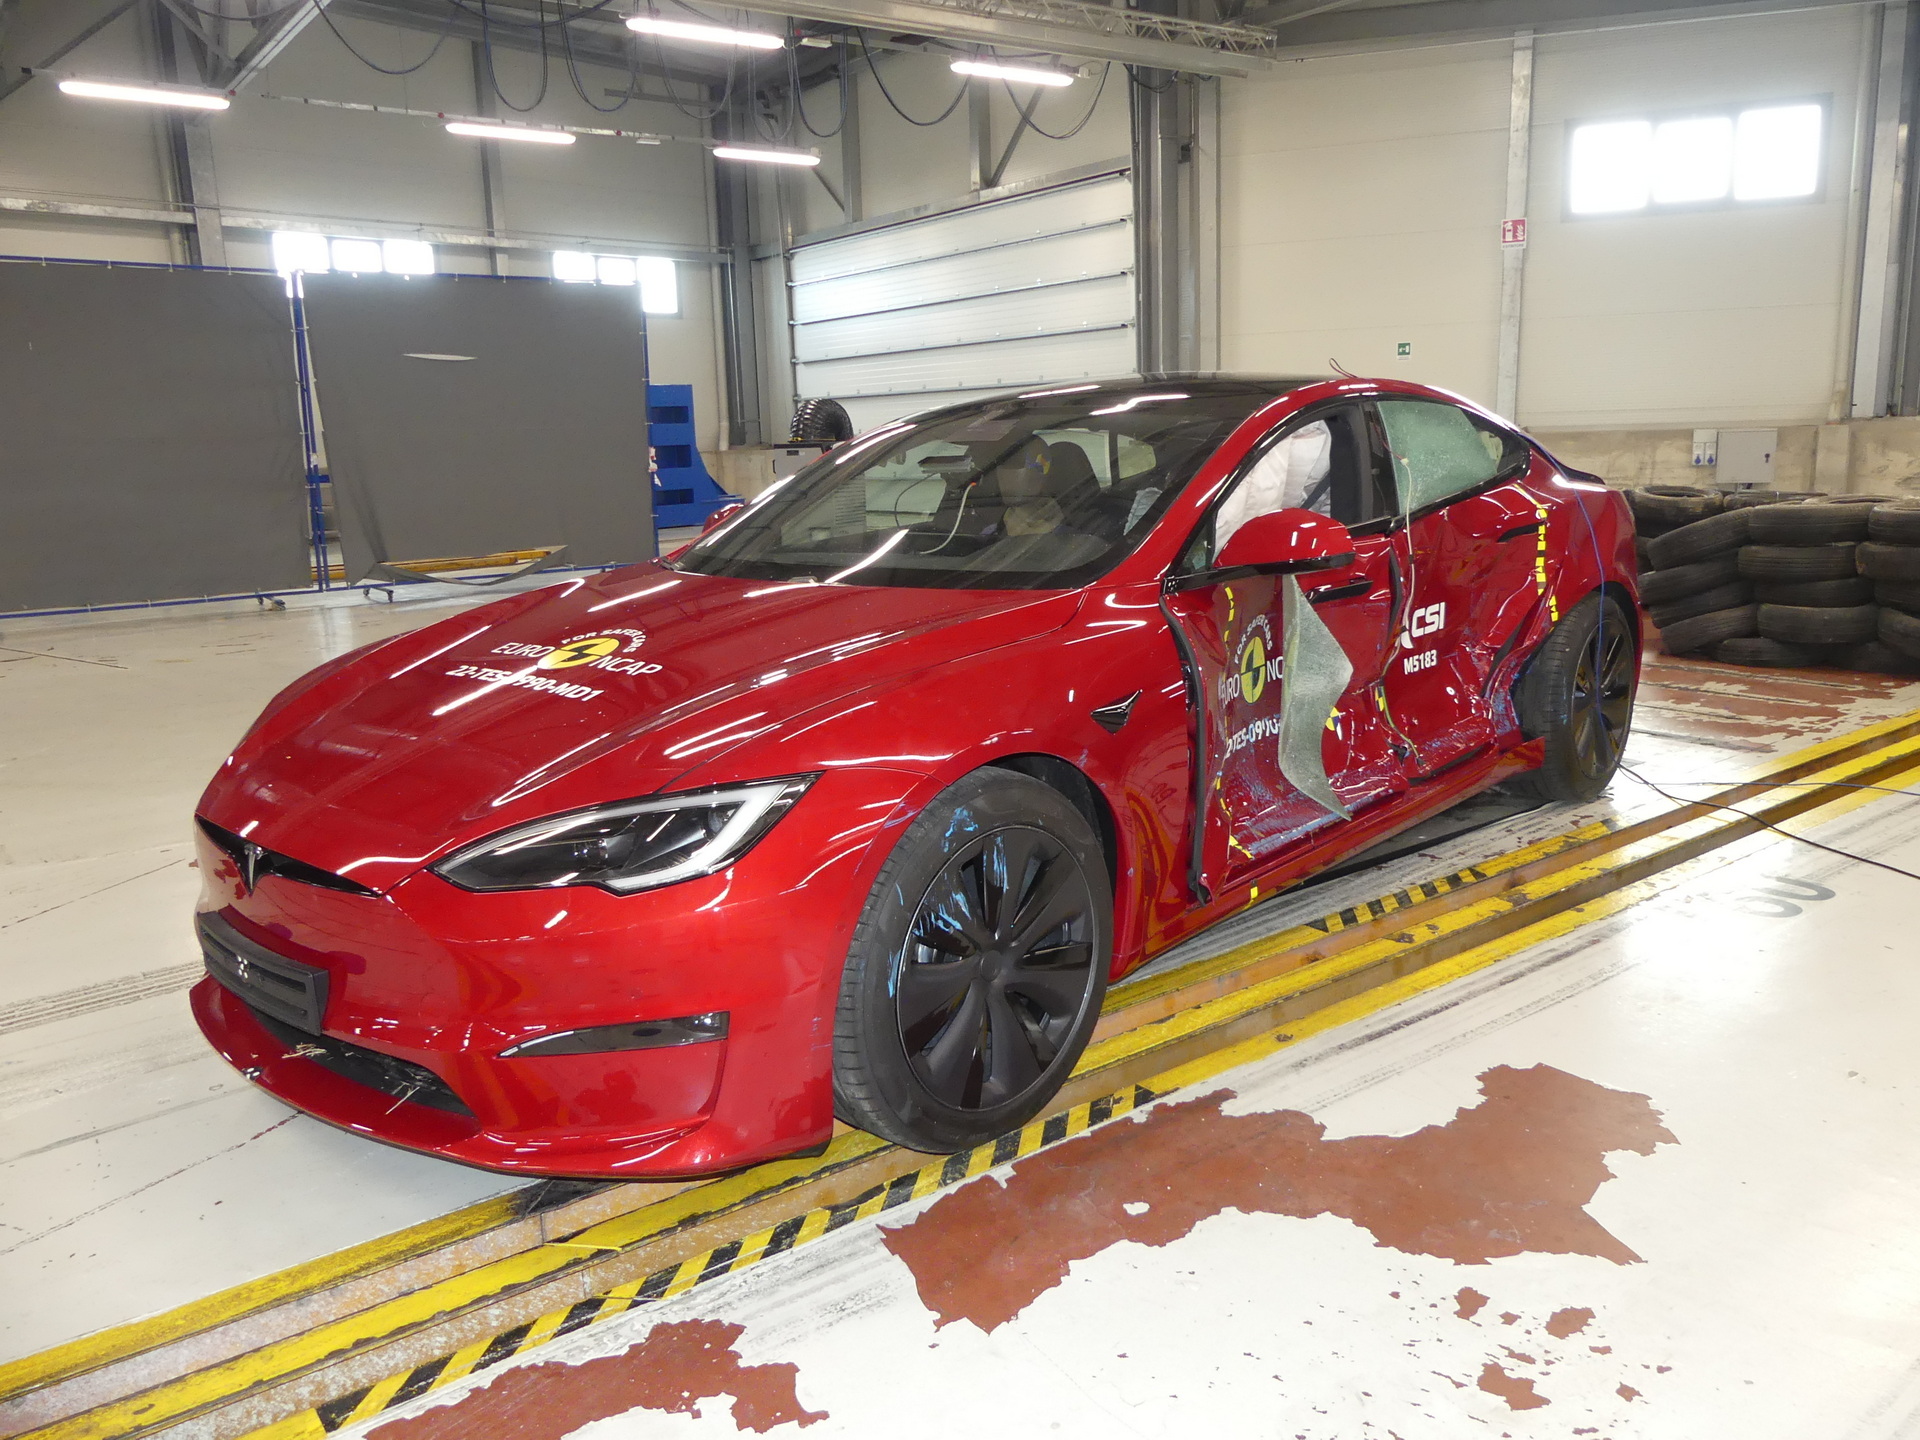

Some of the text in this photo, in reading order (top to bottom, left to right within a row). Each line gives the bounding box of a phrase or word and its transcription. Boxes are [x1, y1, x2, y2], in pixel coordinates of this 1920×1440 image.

[1411, 601, 1446, 638] CSI
[561, 632, 597, 644] FOR
[491, 642, 664, 677] EURO NCAP
[1267, 656, 1284, 682] NC
[1403, 649, 1437, 675] M5183
